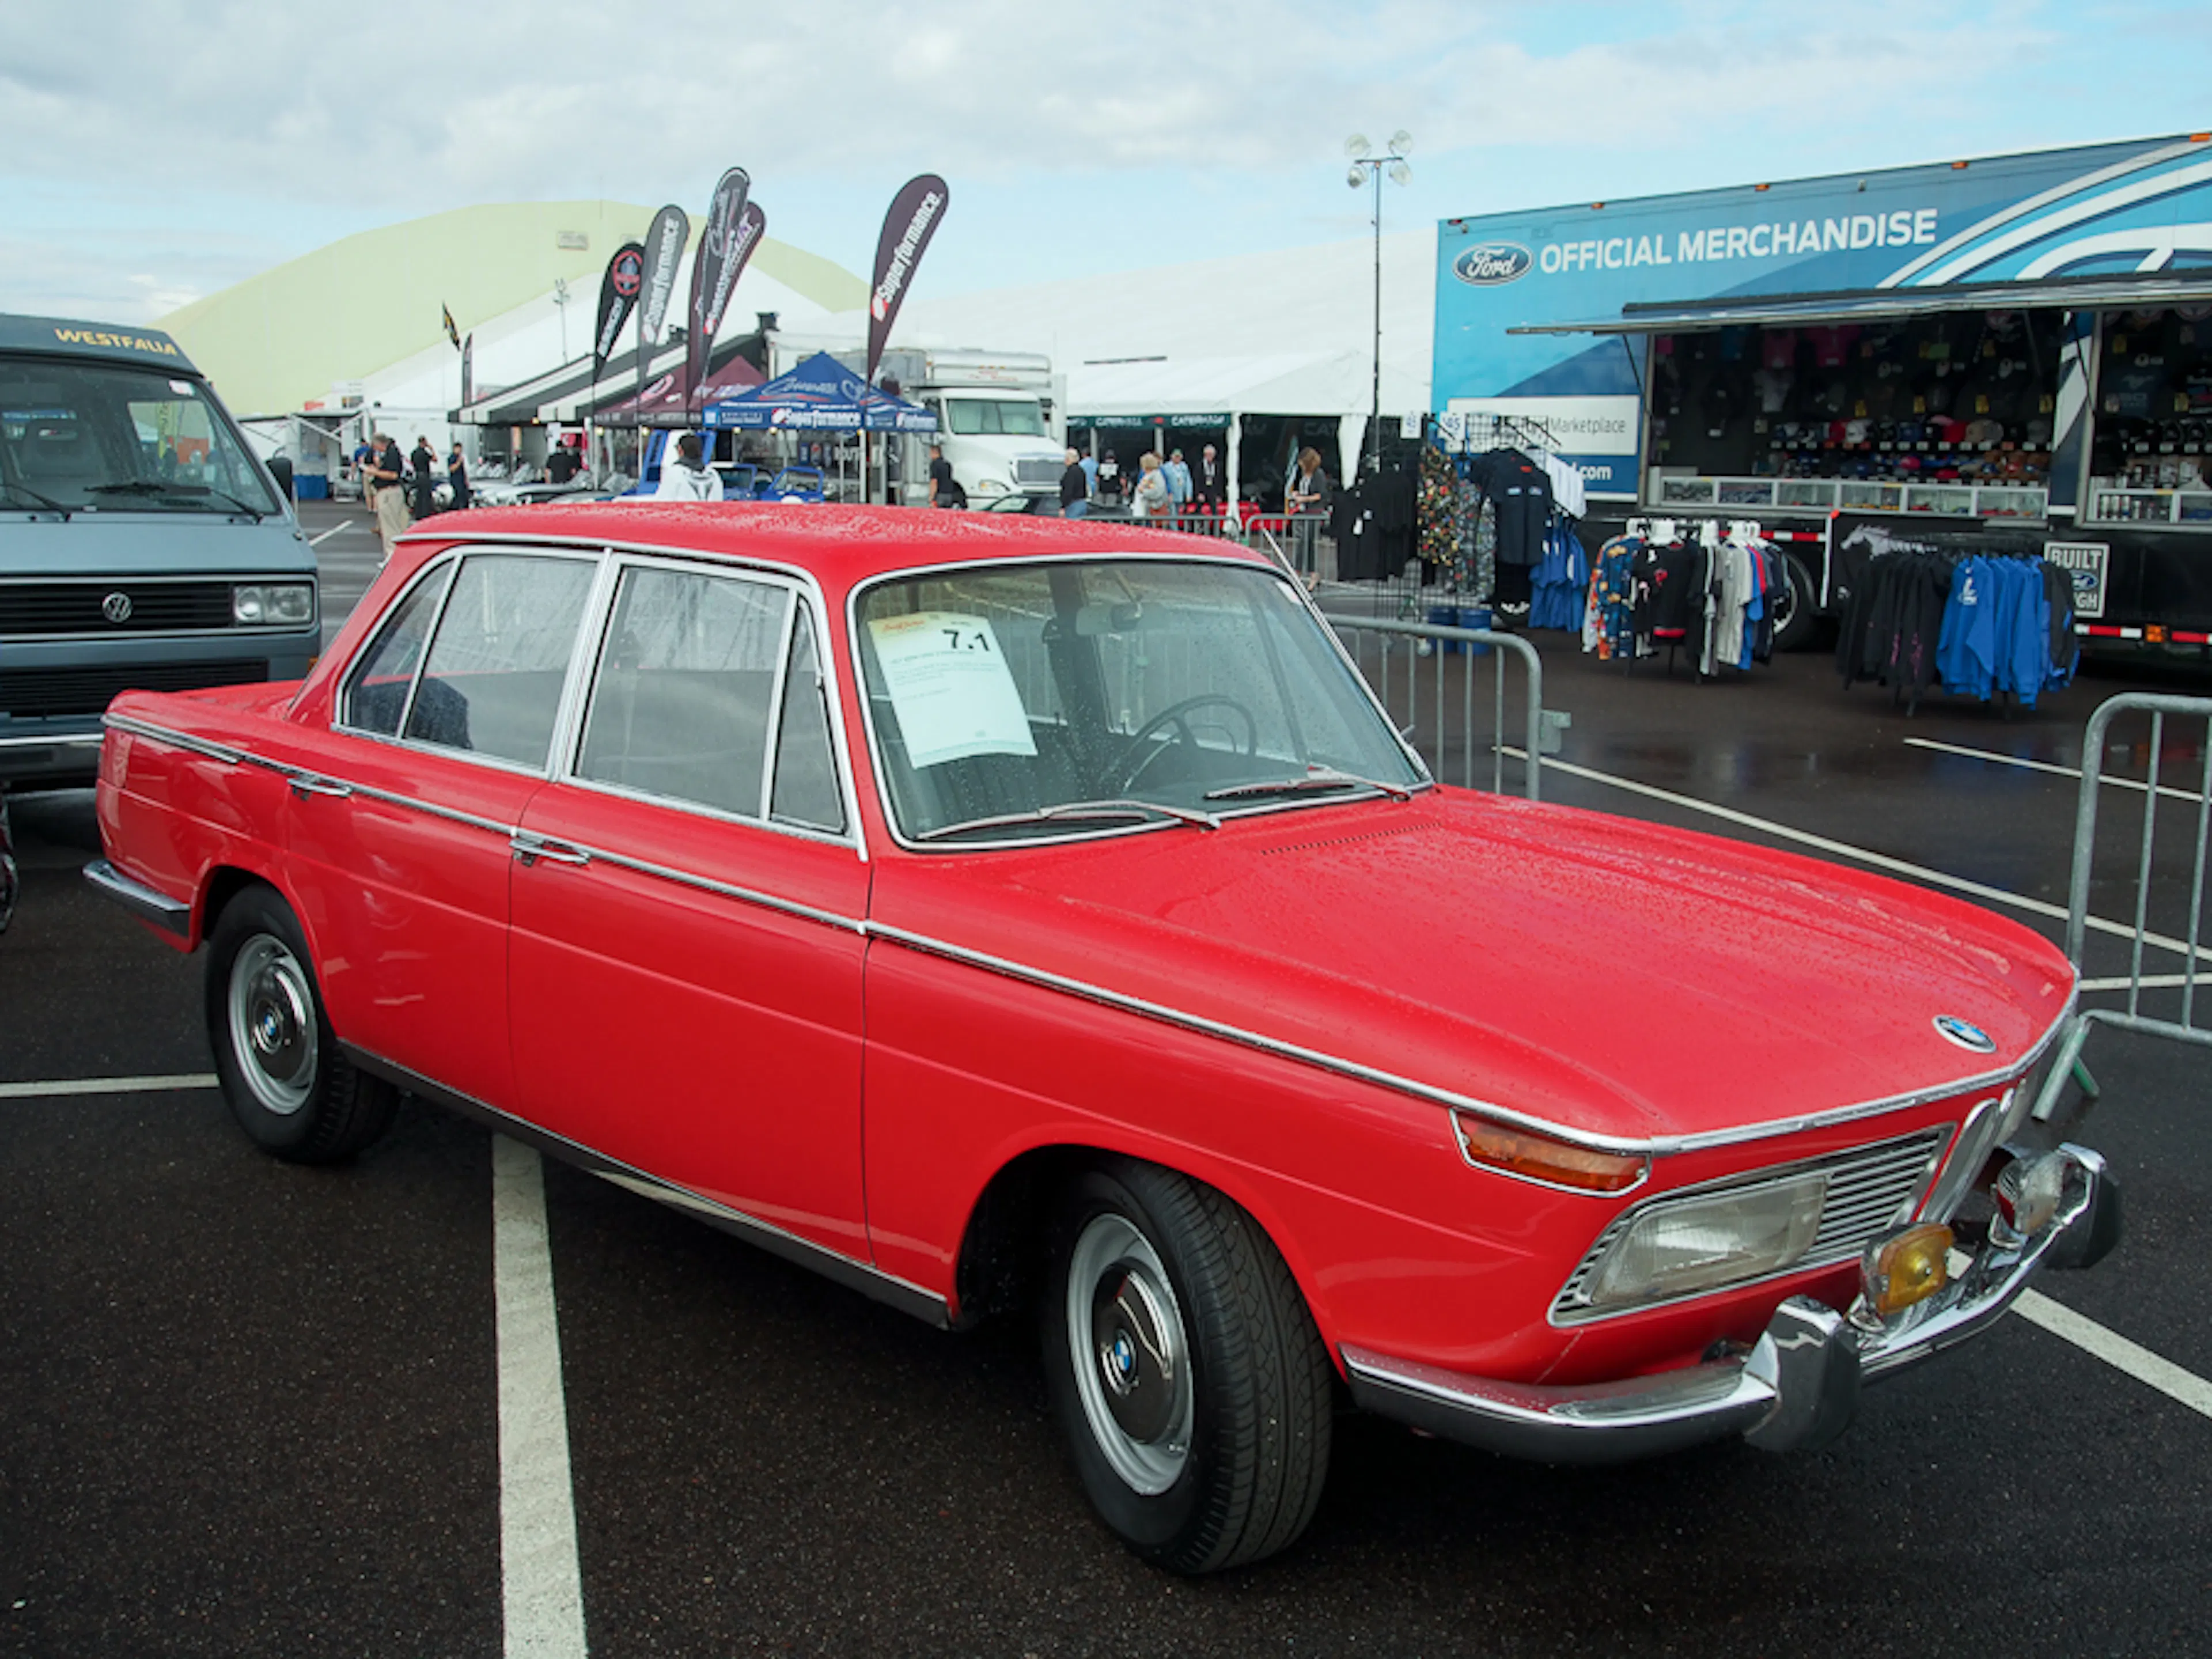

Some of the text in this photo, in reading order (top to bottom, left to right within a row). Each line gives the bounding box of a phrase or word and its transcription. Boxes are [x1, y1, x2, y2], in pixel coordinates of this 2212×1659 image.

[876, 191, 941, 304] Superformance
[1540, 209, 1938, 274] OFFICIAL MERCHANDISE
[1466, 246, 1517, 277] Ford
[54, 327, 178, 357] WESTFALIA
[785, 408, 861, 429] Superformance
[1550, 417, 1627, 435] Marketplace
[1573, 463, 1612, 480] .com
[942, 628, 990, 652] 7.1
